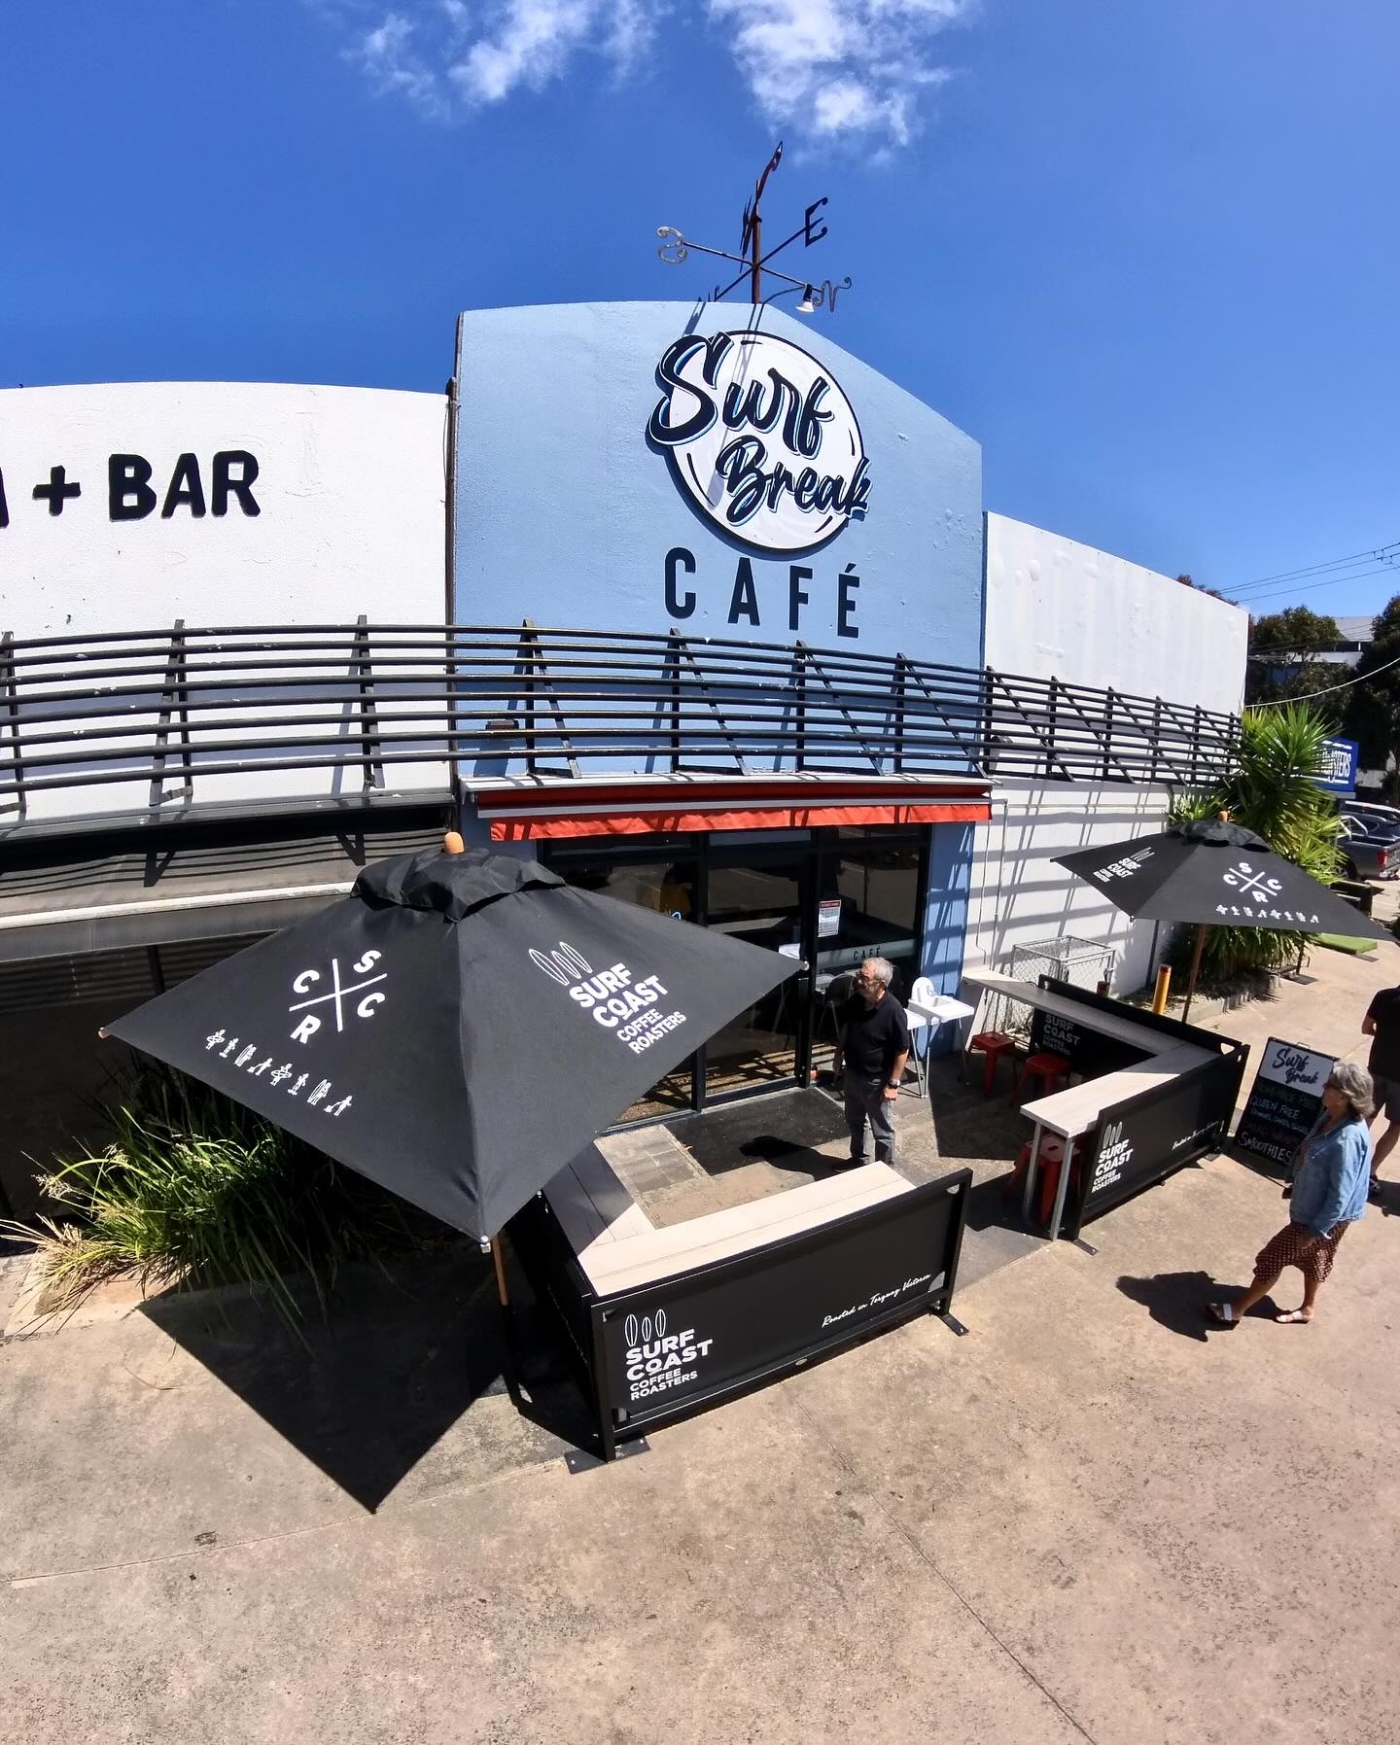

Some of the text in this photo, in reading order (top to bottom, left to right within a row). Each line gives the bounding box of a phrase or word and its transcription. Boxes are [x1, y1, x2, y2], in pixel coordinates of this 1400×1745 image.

[648, 332, 835, 459] Surf
[108, 450, 261, 522] BAR
[715, 434, 872, 526] Break
[664, 546, 860, 639] CAFÉ
[1222, 873, 1282, 891] C C
[353, 950, 382, 973] S
[293, 969, 386, 1018] C C
[569, 963, 632, 1007] SURF
[593, 975, 668, 1028] COAST
[290, 1014, 321, 1044] R
[617, 1008, 663, 1041] COFFEE
[628, 1011, 687, 1054] ROASTERS
[1043, 1023, 1081, 1046] COAST
[1045, 1013, 1074, 1031] SURF
[1272, 1046, 1309, 1073] Surf
[1285, 1067, 1319, 1084] Break
[1279, 1104, 1300, 1119] FREE
[1094, 1149, 1134, 1176] COAST
[1098, 1139, 1129, 1163] SURF
[1092, 1173, 1121, 1193] ROASTERS
[1093, 1169, 1117, 1186] COFFEE
[822, 1308, 856, 1327] Roasted
[626, 1329, 695, 1365] SURF
[626, 1339, 713, 1381] COAST
[630, 1367, 682, 1392] COFFEE
[630, 1370, 698, 1401] ROASTERS
